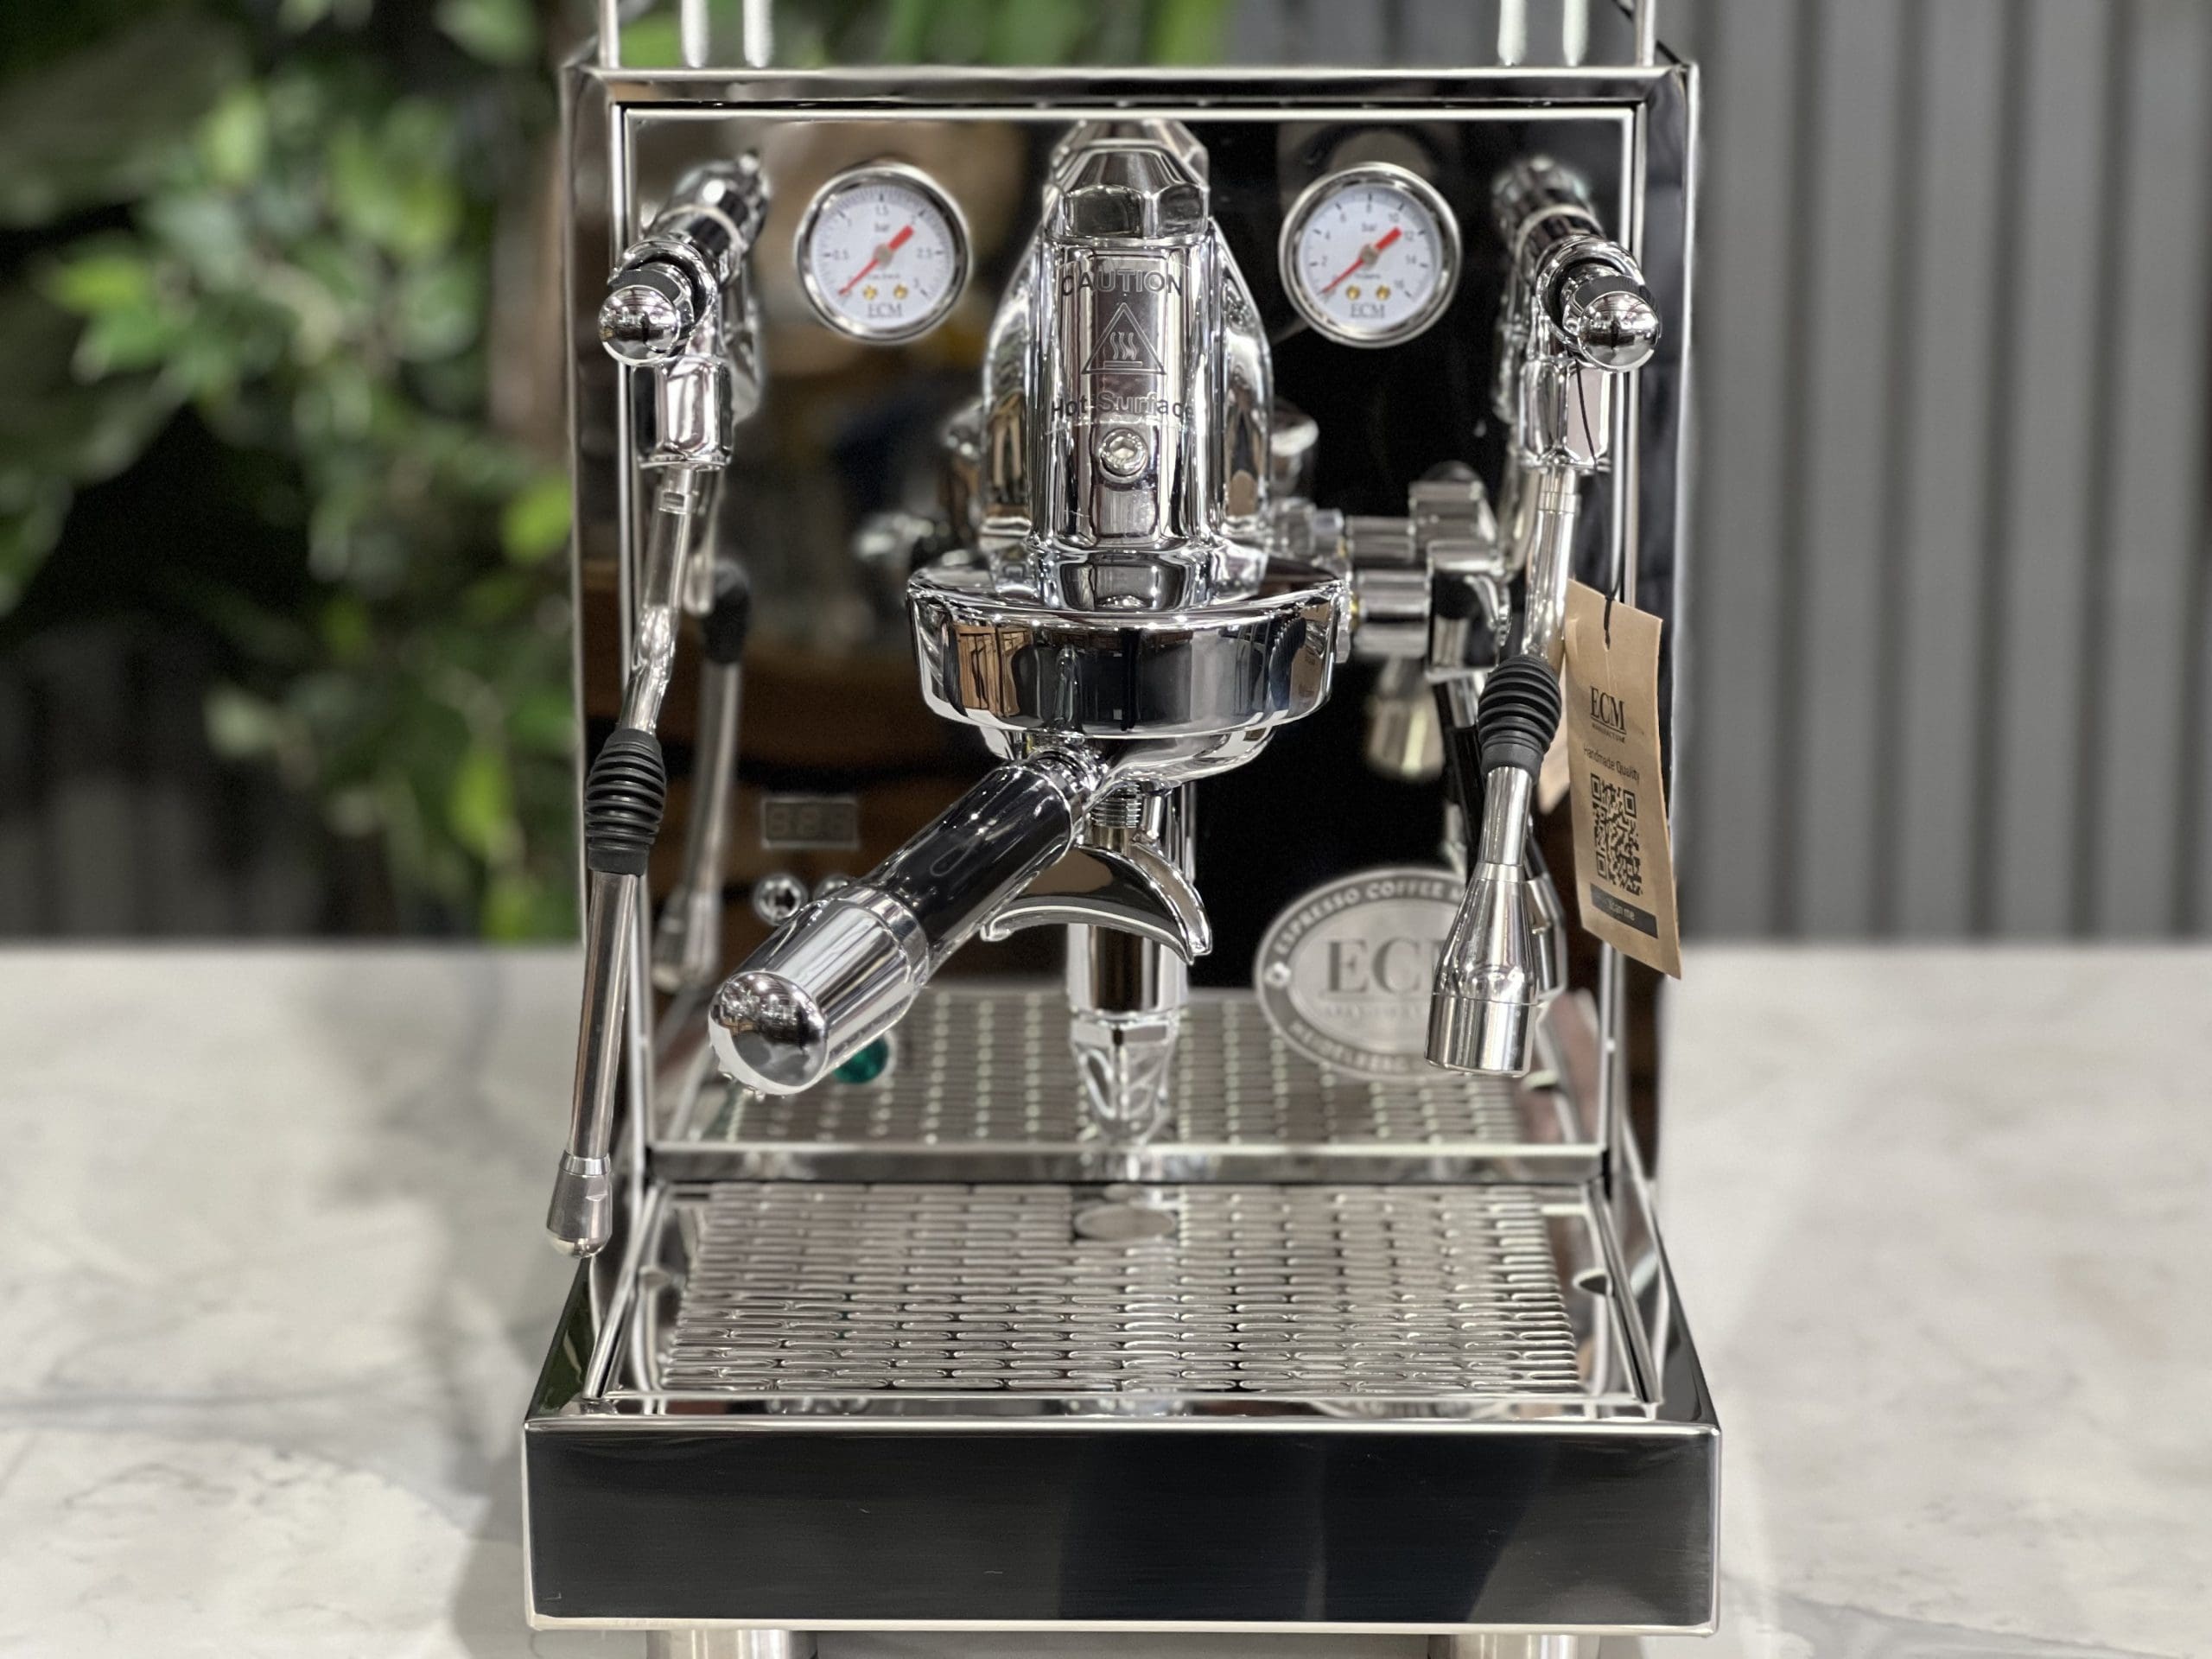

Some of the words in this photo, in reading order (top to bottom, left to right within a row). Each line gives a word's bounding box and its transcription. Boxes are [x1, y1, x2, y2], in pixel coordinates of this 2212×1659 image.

[874, 221, 890, 232] bar
[1361, 221, 1377, 232] bar
[1060, 270, 1183, 296] CAUTION
[868, 303, 903, 318] ECM
[1351, 303, 1386, 318] ECM
[1052, 394, 1088, 422] Hot
[1096, 391, 1195, 421] Surface
[1590, 685, 1625, 731] ECM
[1584, 744, 1615, 771] Handmade
[1616, 760, 1640, 781] Quality
[1274, 887, 1360, 954] ESPRESSO
[1366, 881, 1444, 899] COFFEE
[1327, 938, 1445, 994] EC
